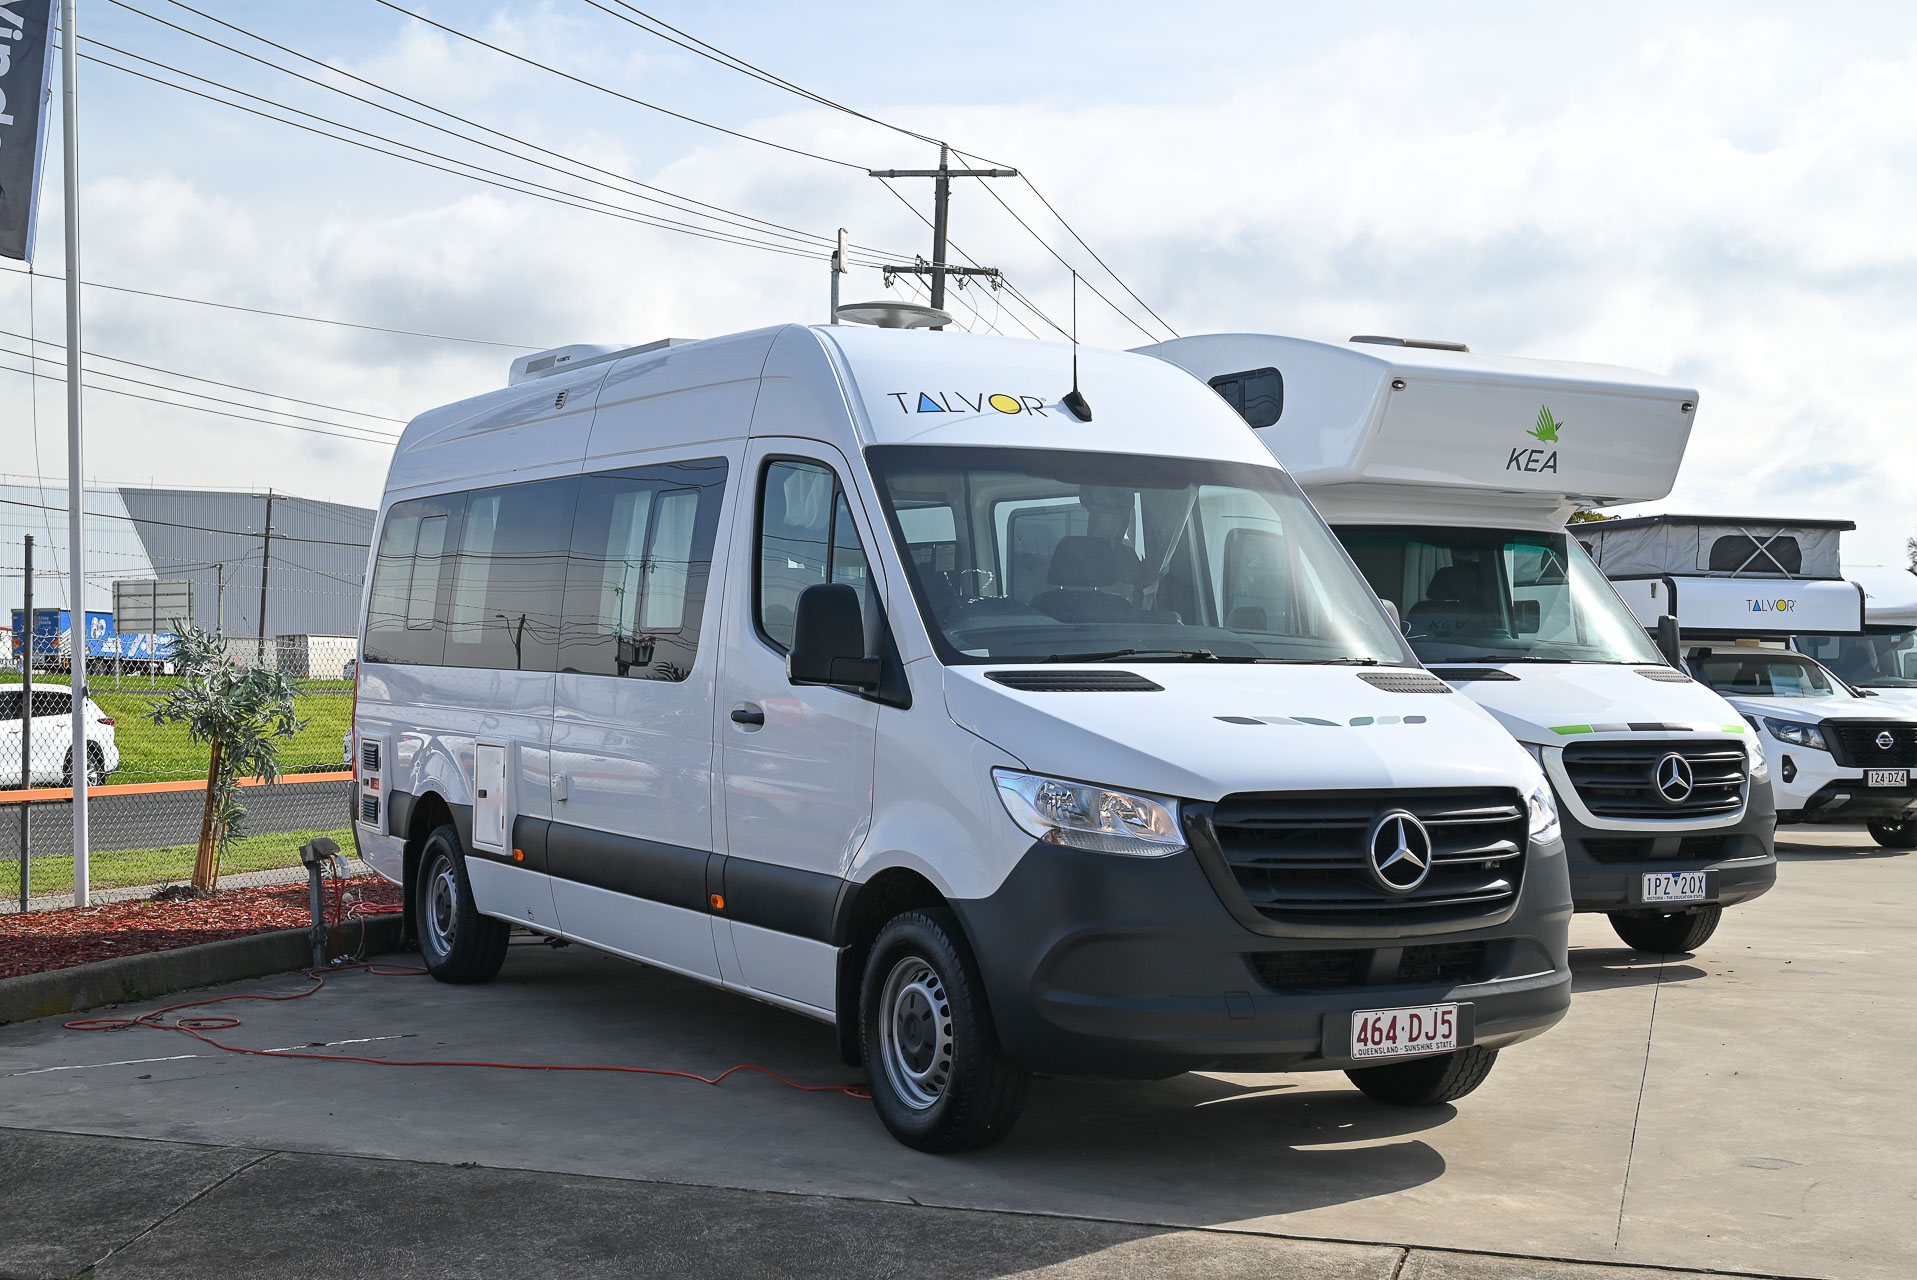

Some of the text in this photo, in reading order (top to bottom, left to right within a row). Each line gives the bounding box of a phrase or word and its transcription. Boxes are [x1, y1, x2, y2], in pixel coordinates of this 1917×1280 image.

[887, 391, 1048, 418] TALVOR
[1505, 447, 1557, 474] KEA
[1745, 599, 1794, 612] TALVOR
[1357, 1045, 1399, 1056] QUEENSLAND
[1404, 1042, 1434, 1052] SUNSHINE
[1435, 1040, 1453, 1050] STATE
